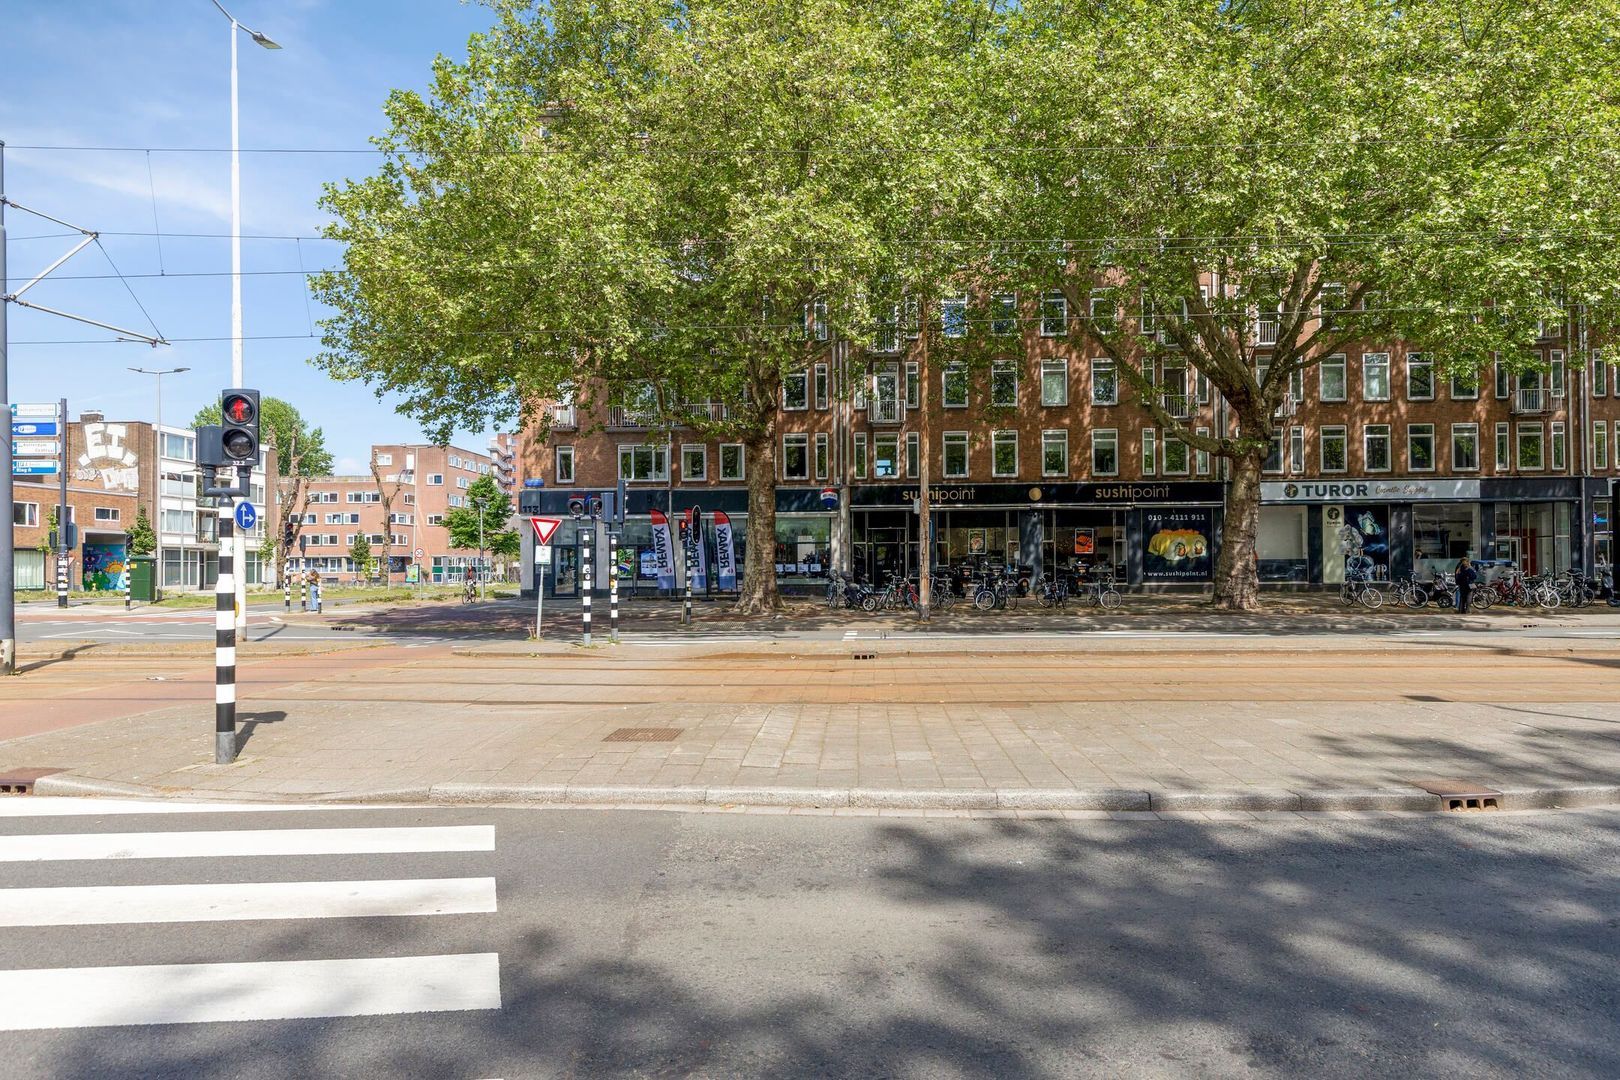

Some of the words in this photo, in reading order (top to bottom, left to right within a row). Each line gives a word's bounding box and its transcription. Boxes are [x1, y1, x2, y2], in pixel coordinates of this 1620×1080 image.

[902, 487, 976, 504] suhipoint
[1095, 485, 1170, 502] sushipoint
[1302, 484, 1368, 497] TUROR
[522, 505, 539, 513] 113
